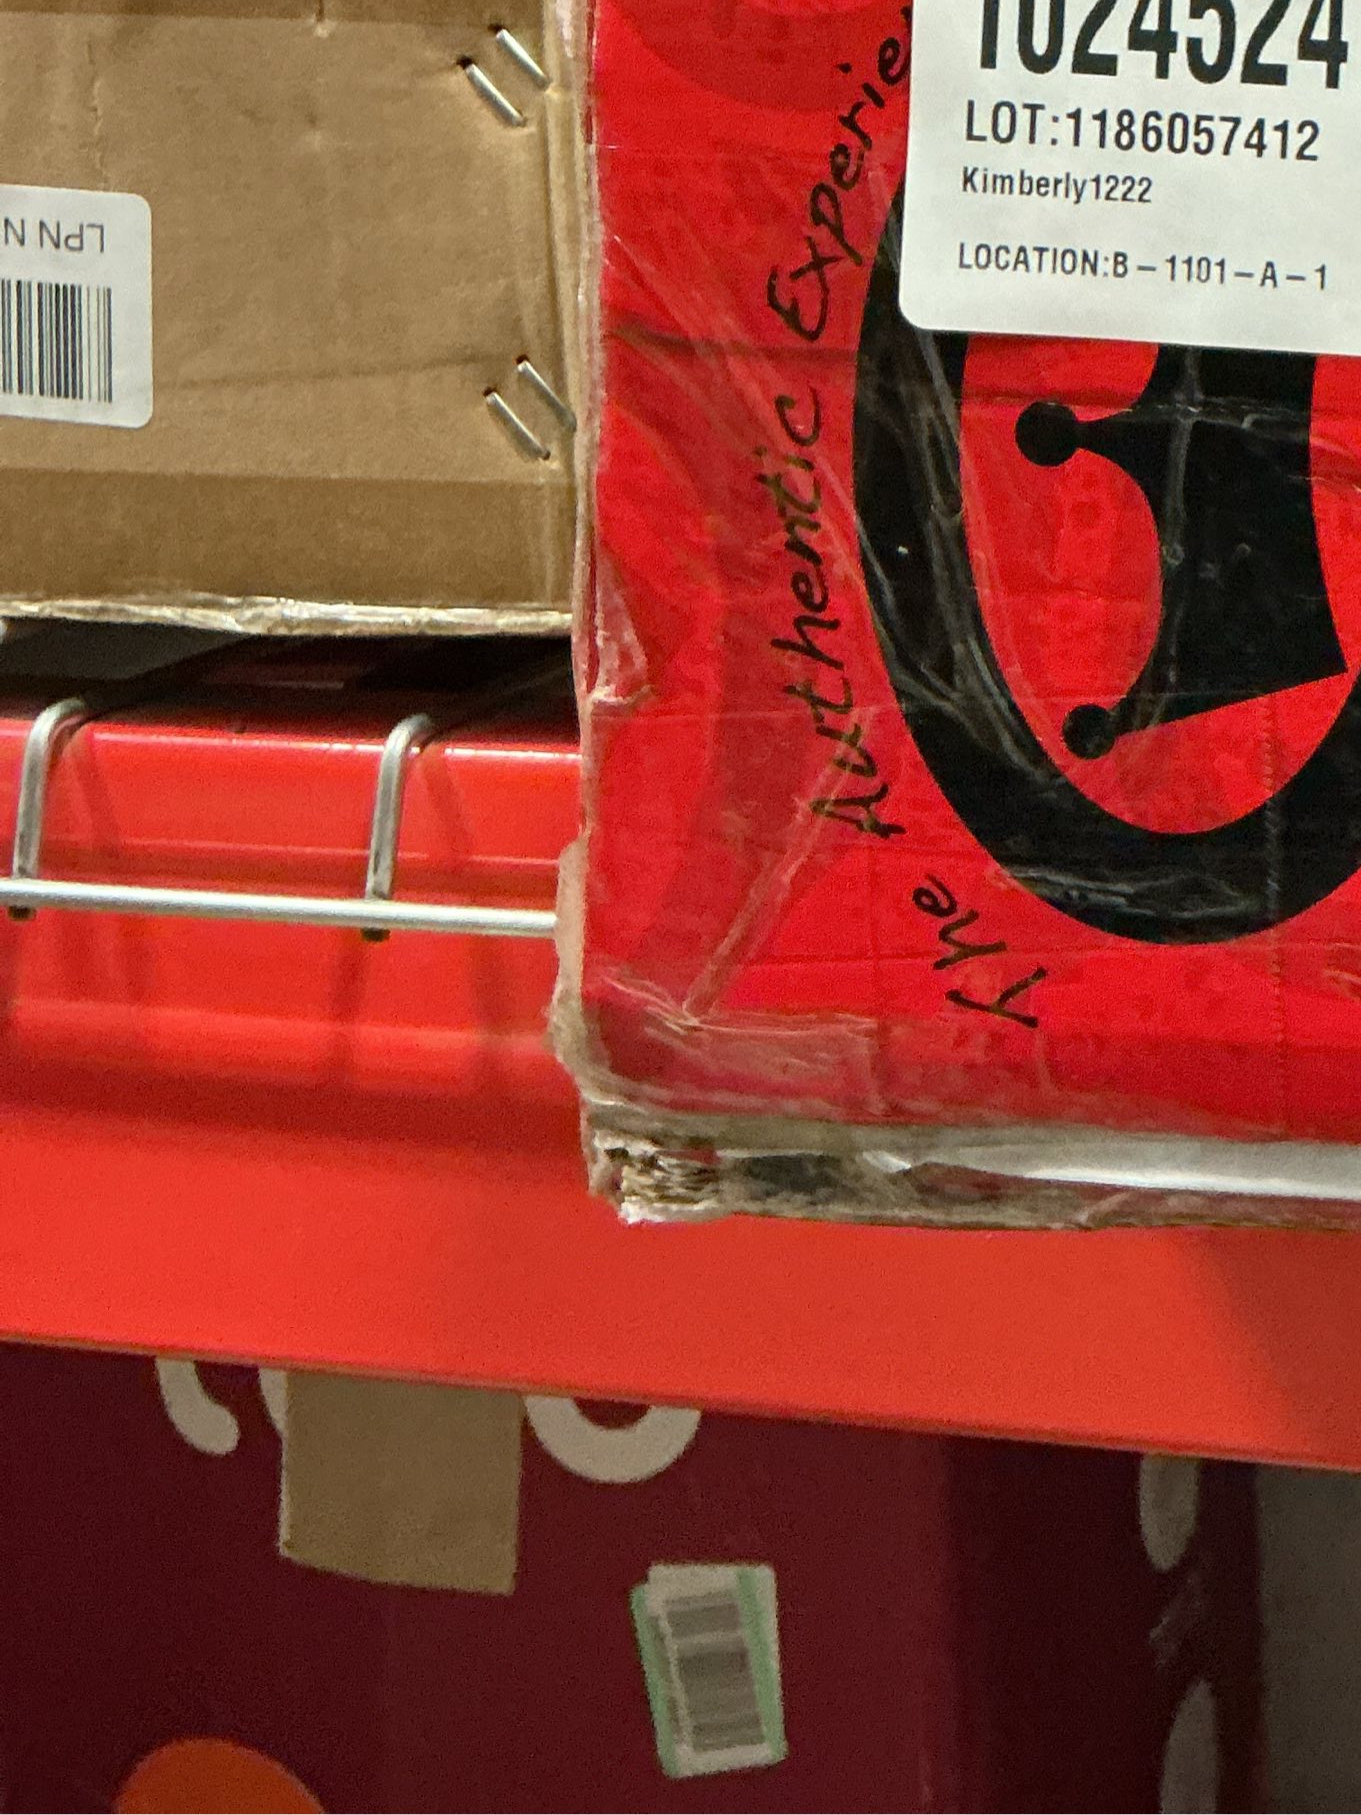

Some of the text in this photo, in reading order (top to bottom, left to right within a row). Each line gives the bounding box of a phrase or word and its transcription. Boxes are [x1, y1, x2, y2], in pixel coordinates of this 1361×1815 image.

[965, 99, 1320, 162] LOT:1186057412
[962, 165, 1153, 205] Kimberly1222
[39, 219, 104, 253] LPN
[751, 5, 1049, 1030] The Authentic Experie
